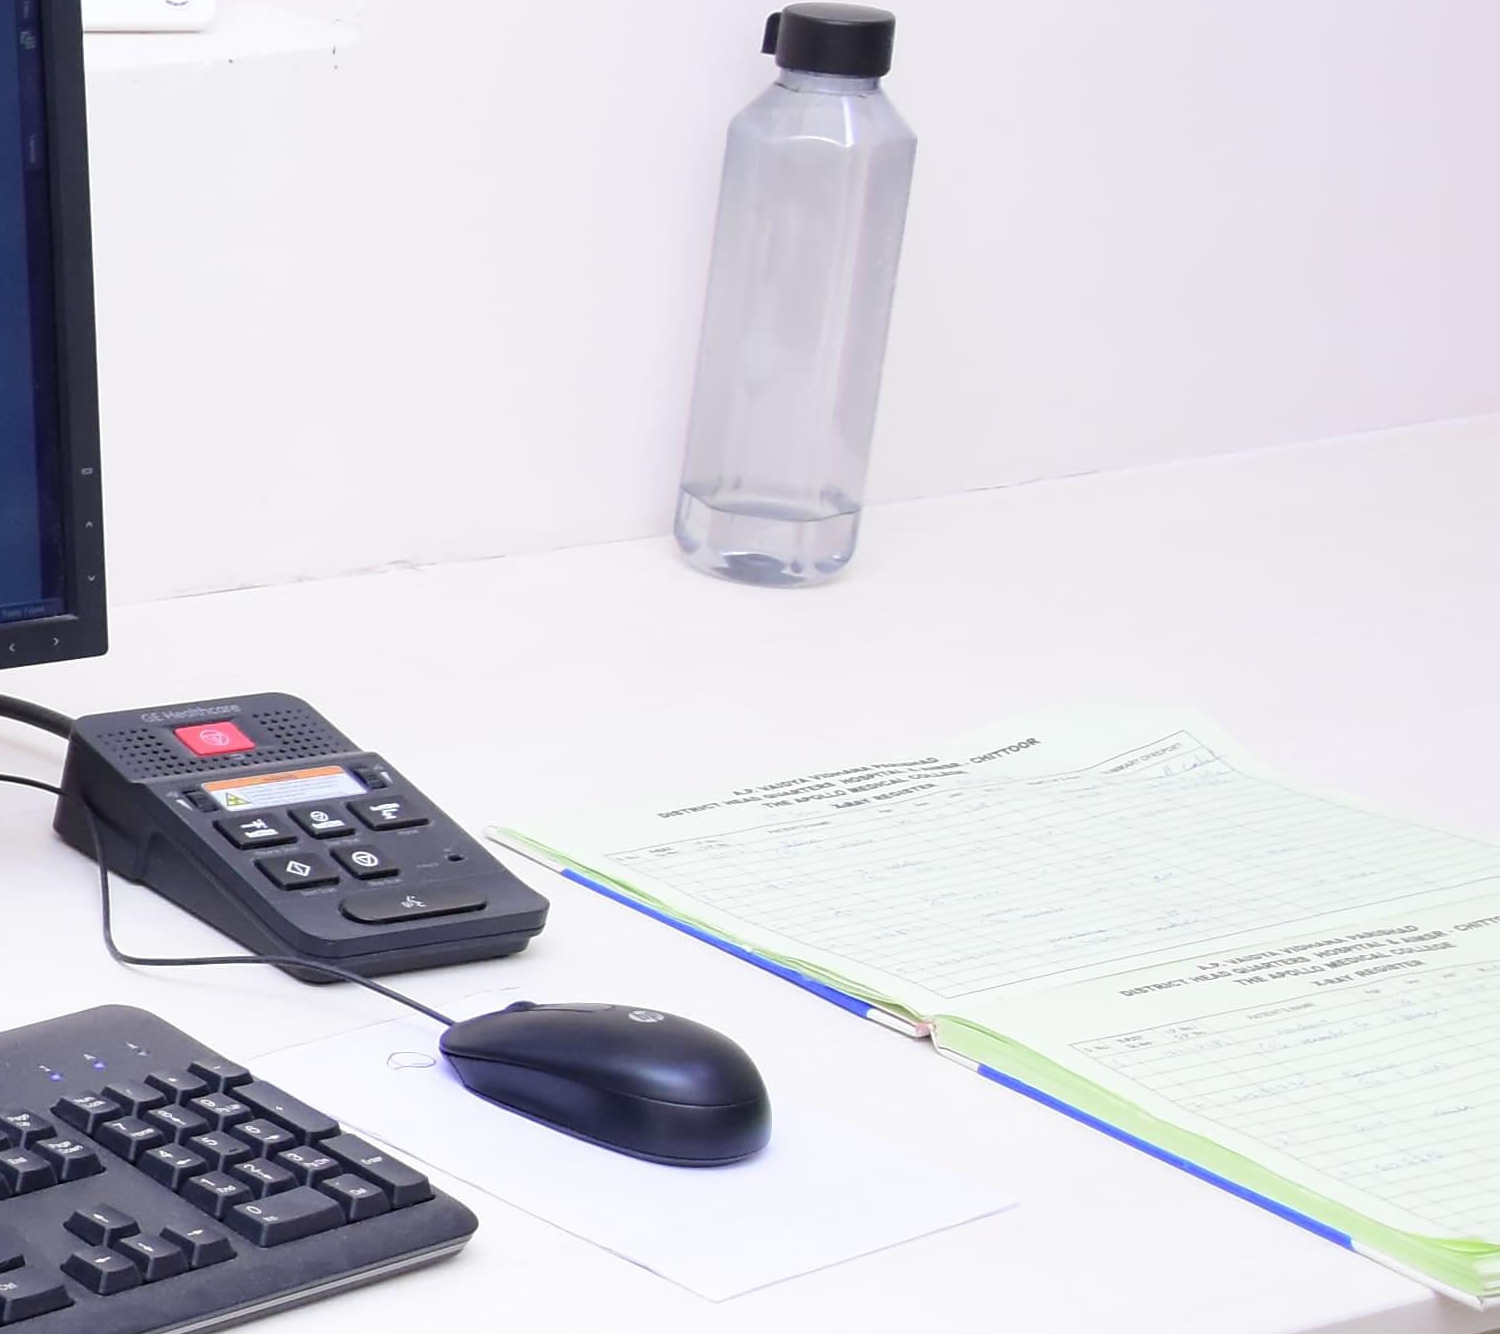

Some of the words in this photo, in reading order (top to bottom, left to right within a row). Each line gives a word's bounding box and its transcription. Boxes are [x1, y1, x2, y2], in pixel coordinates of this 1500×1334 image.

[141, 711, 165, 724] GE
[164, 702, 242, 722] Healthcare
[656, 801, 722, 820] DISTRICT
[968, 736, 1042, 766] CHITTOOR
[761, 799, 794, 811] THE
[1119, 978, 1190, 998] DISTRICT
[1313, 939, 1387, 960] HOSPITAL
[1232, 976, 1266, 988] THE
[1266, 963, 1325, 983] APOLLO
[1325, 950, 1390, 970] MEDICAL
